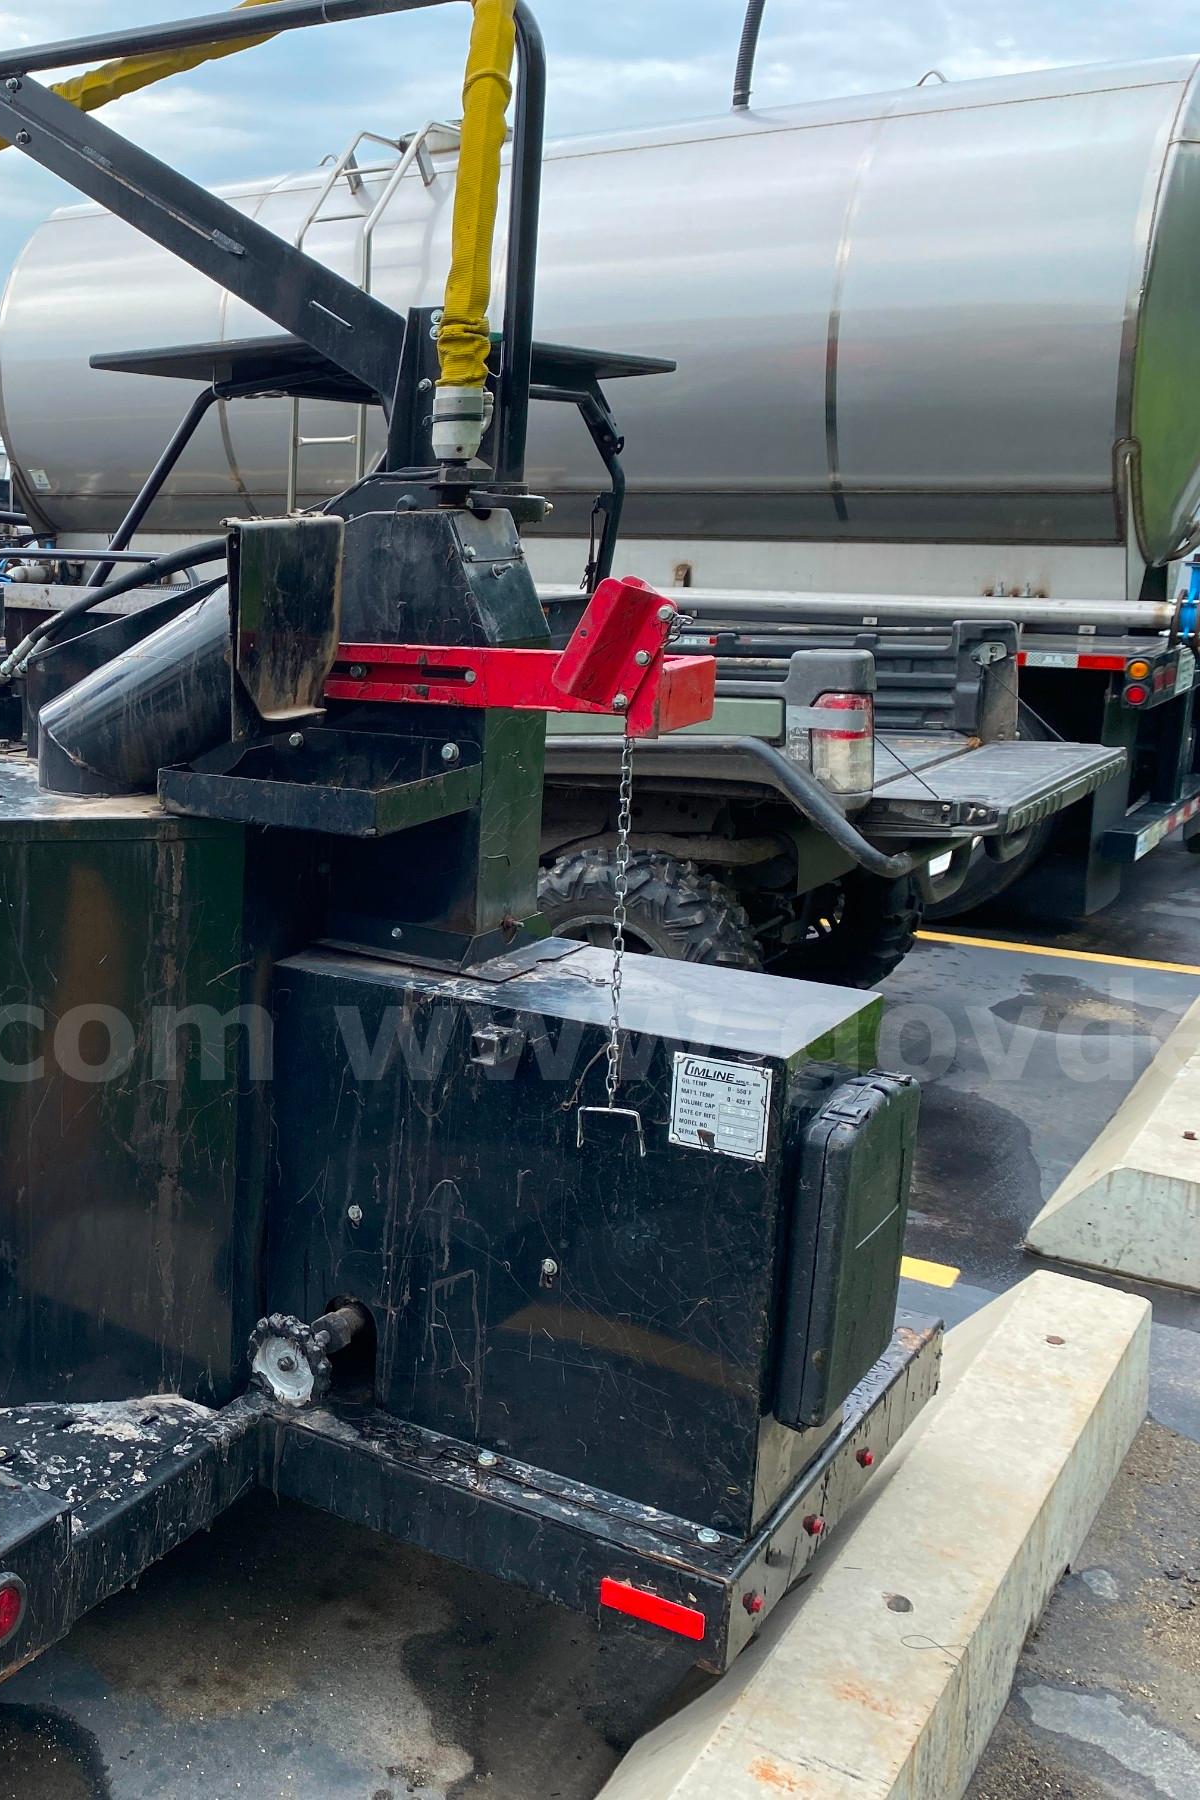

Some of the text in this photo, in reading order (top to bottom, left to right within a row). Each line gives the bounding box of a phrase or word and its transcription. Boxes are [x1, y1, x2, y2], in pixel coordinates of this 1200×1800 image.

[684, 1060, 736, 1083] CIMLINE
[699, 1090, 715, 1099] TEMP
[680, 1097, 716, 1110] VOLUME CAP
[679, 1107, 695, 1115] DATE
[678, 1117, 698, 1127] MODEL
